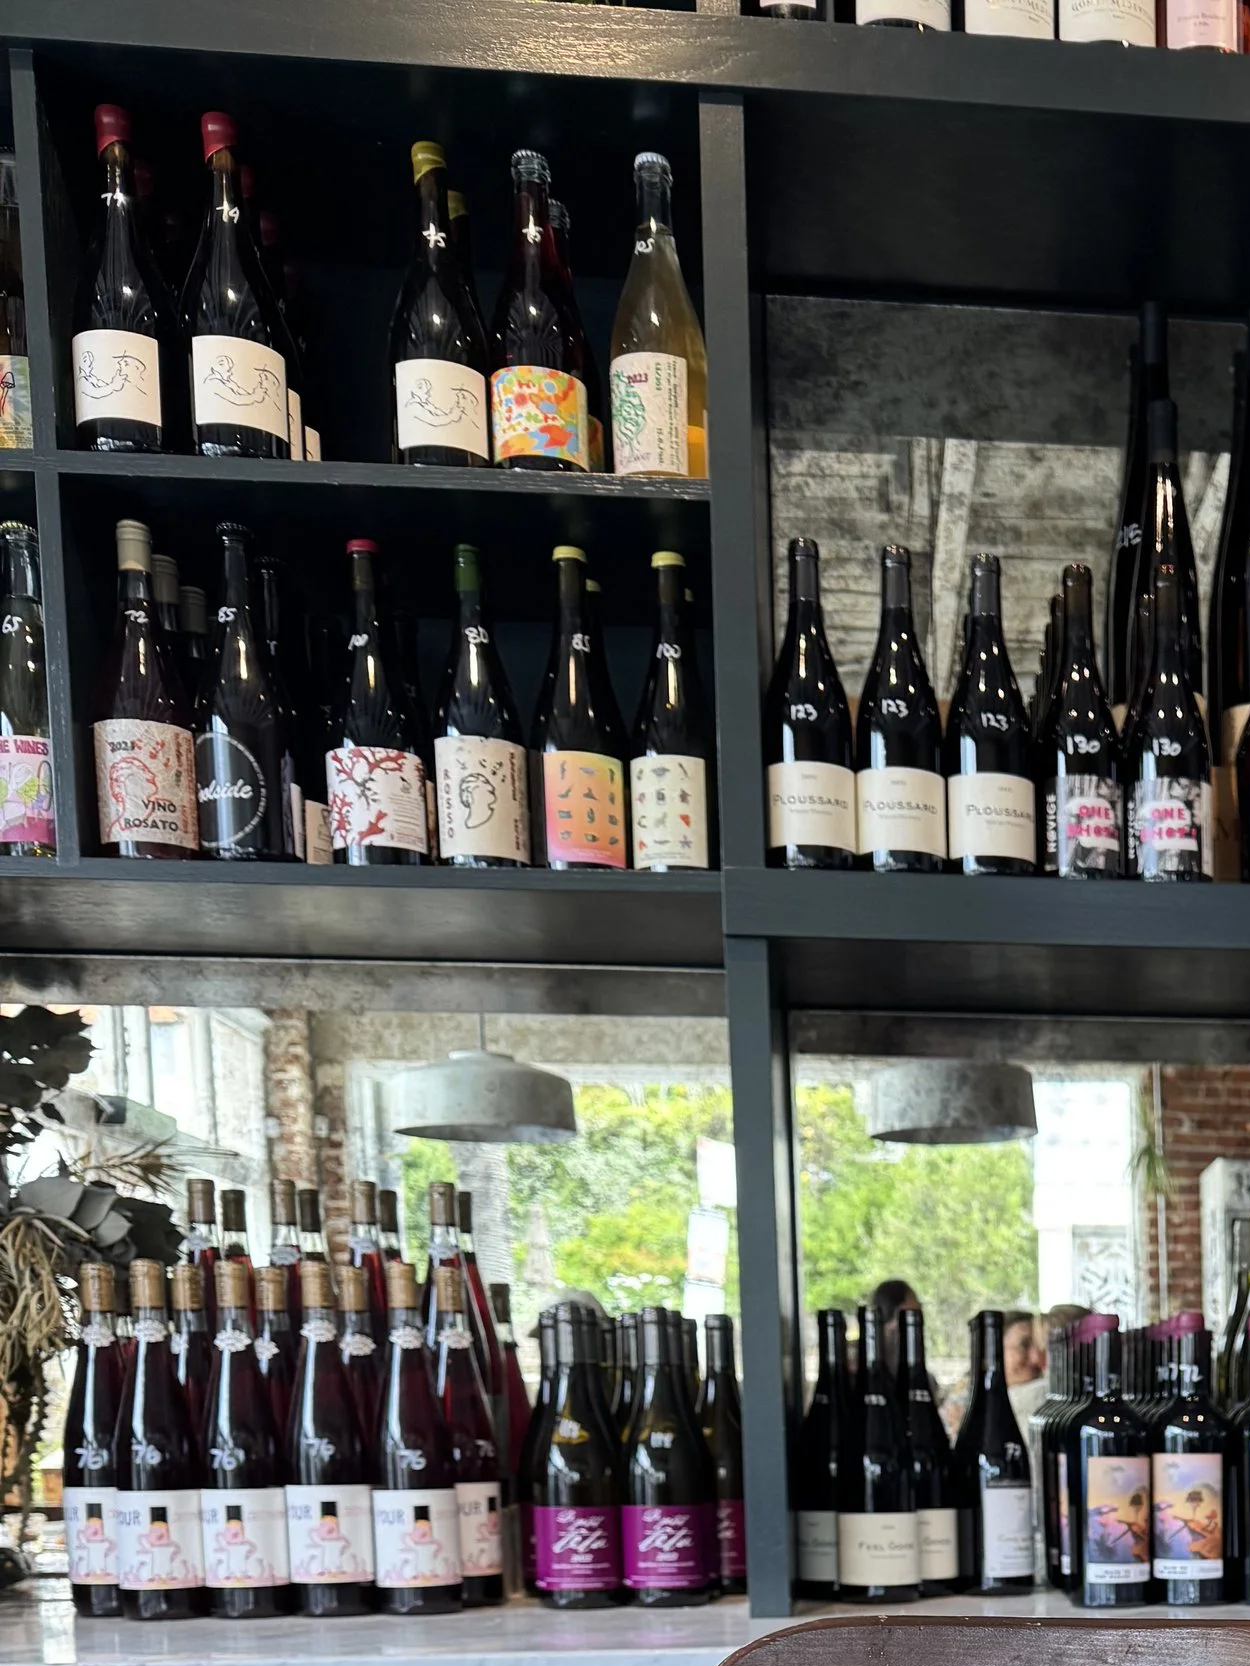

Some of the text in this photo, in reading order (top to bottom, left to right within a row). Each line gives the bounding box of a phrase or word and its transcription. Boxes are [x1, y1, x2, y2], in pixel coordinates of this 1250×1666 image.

[1, 614, 23, 634] 65
[218, 606, 238, 623] 85
[790, 703, 818, 721] 123
[881, 698, 910, 718] 123
[981, 711, 1009, 731] 123
[14, 738, 49, 756] WINES
[1066, 734, 1101, 755] 130
[1153, 737, 1182, 757] 130
[142, 799, 178, 814] VINO
[124, 817, 180, 832] ROSATO
